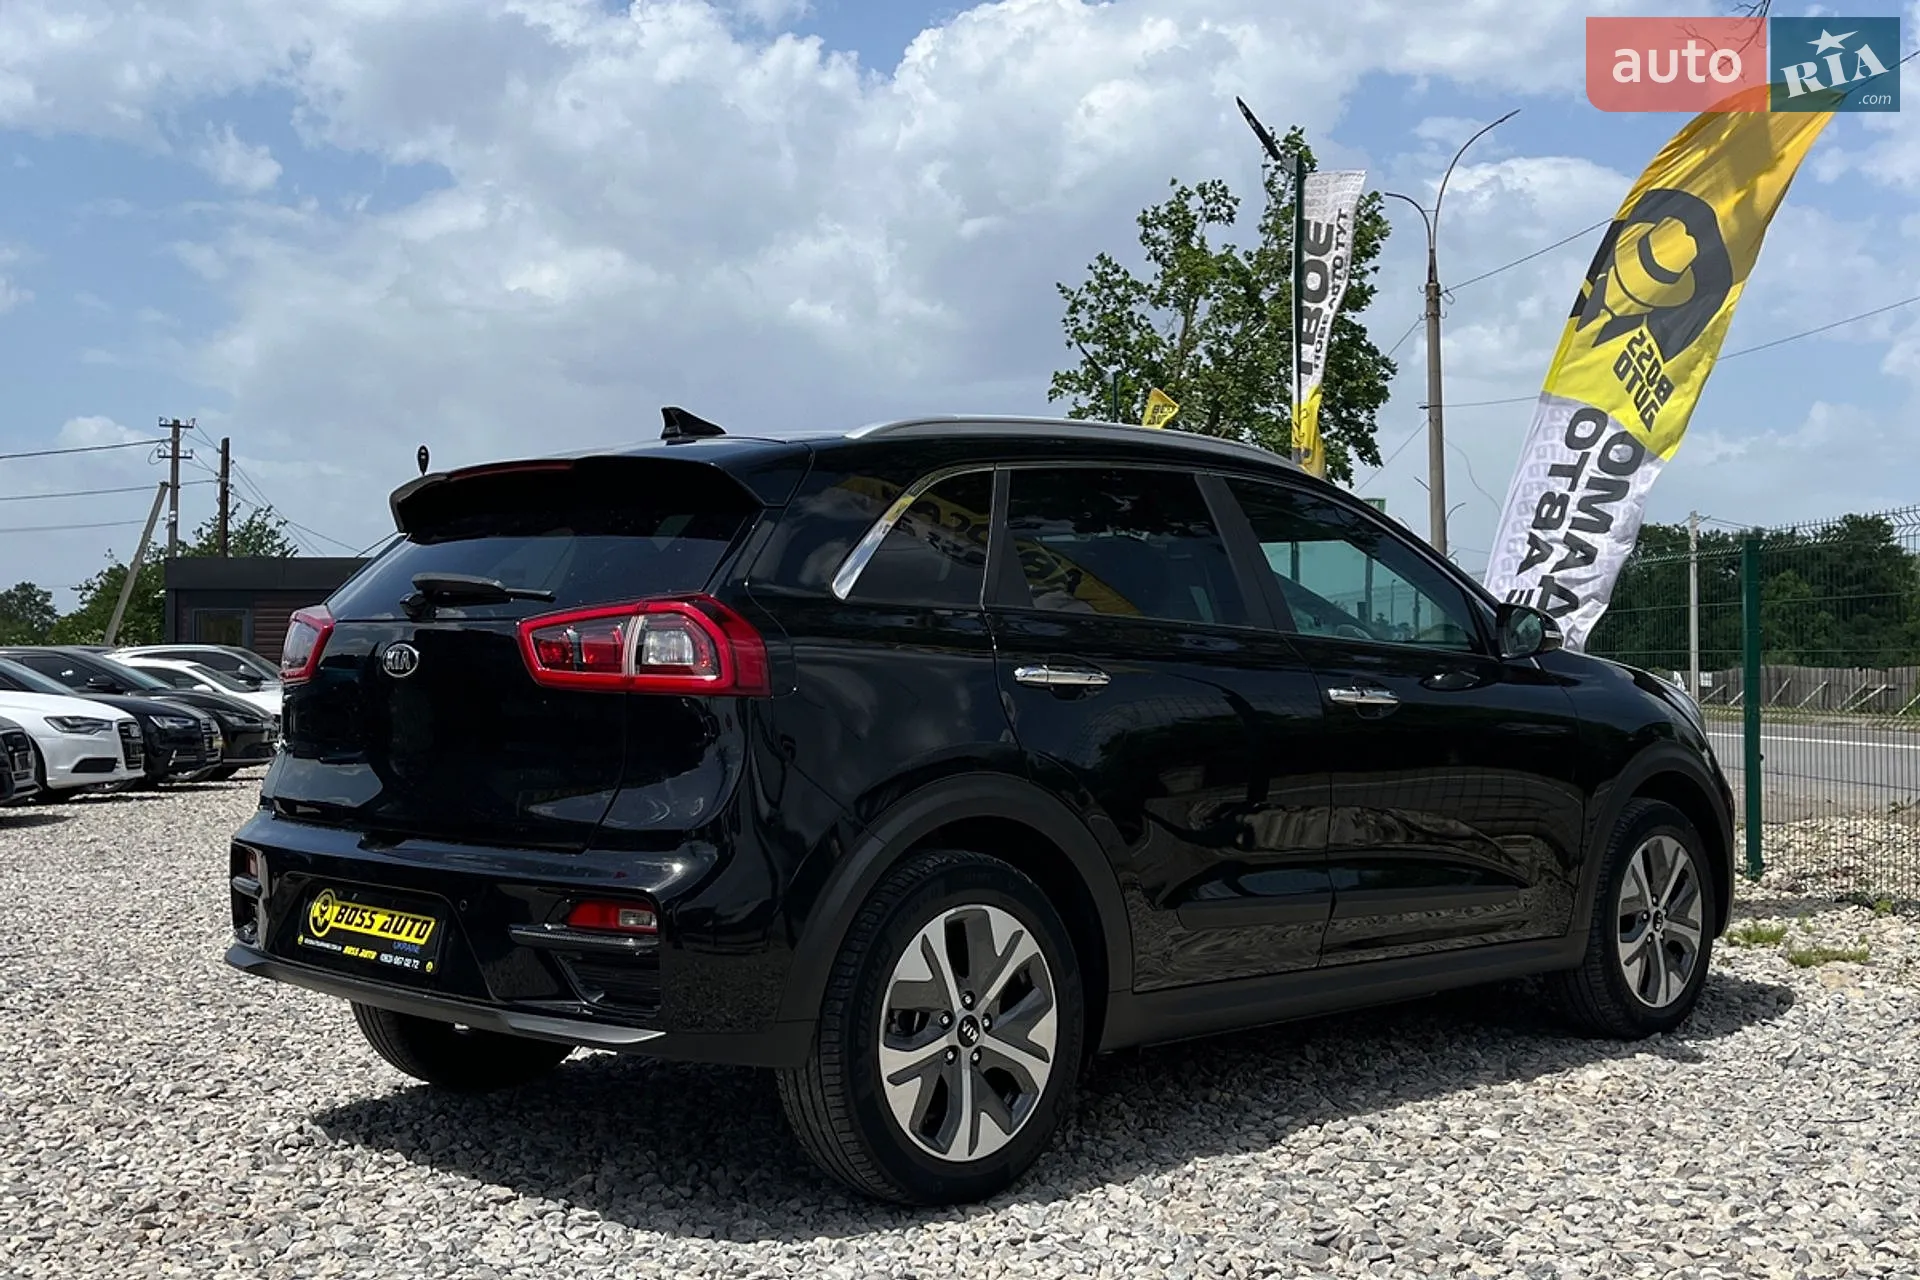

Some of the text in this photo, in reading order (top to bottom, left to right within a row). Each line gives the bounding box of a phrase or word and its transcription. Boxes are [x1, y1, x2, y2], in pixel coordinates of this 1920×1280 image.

[386, 650, 411, 670] KIA
[334, 905, 431, 940] BOSS AUTO
